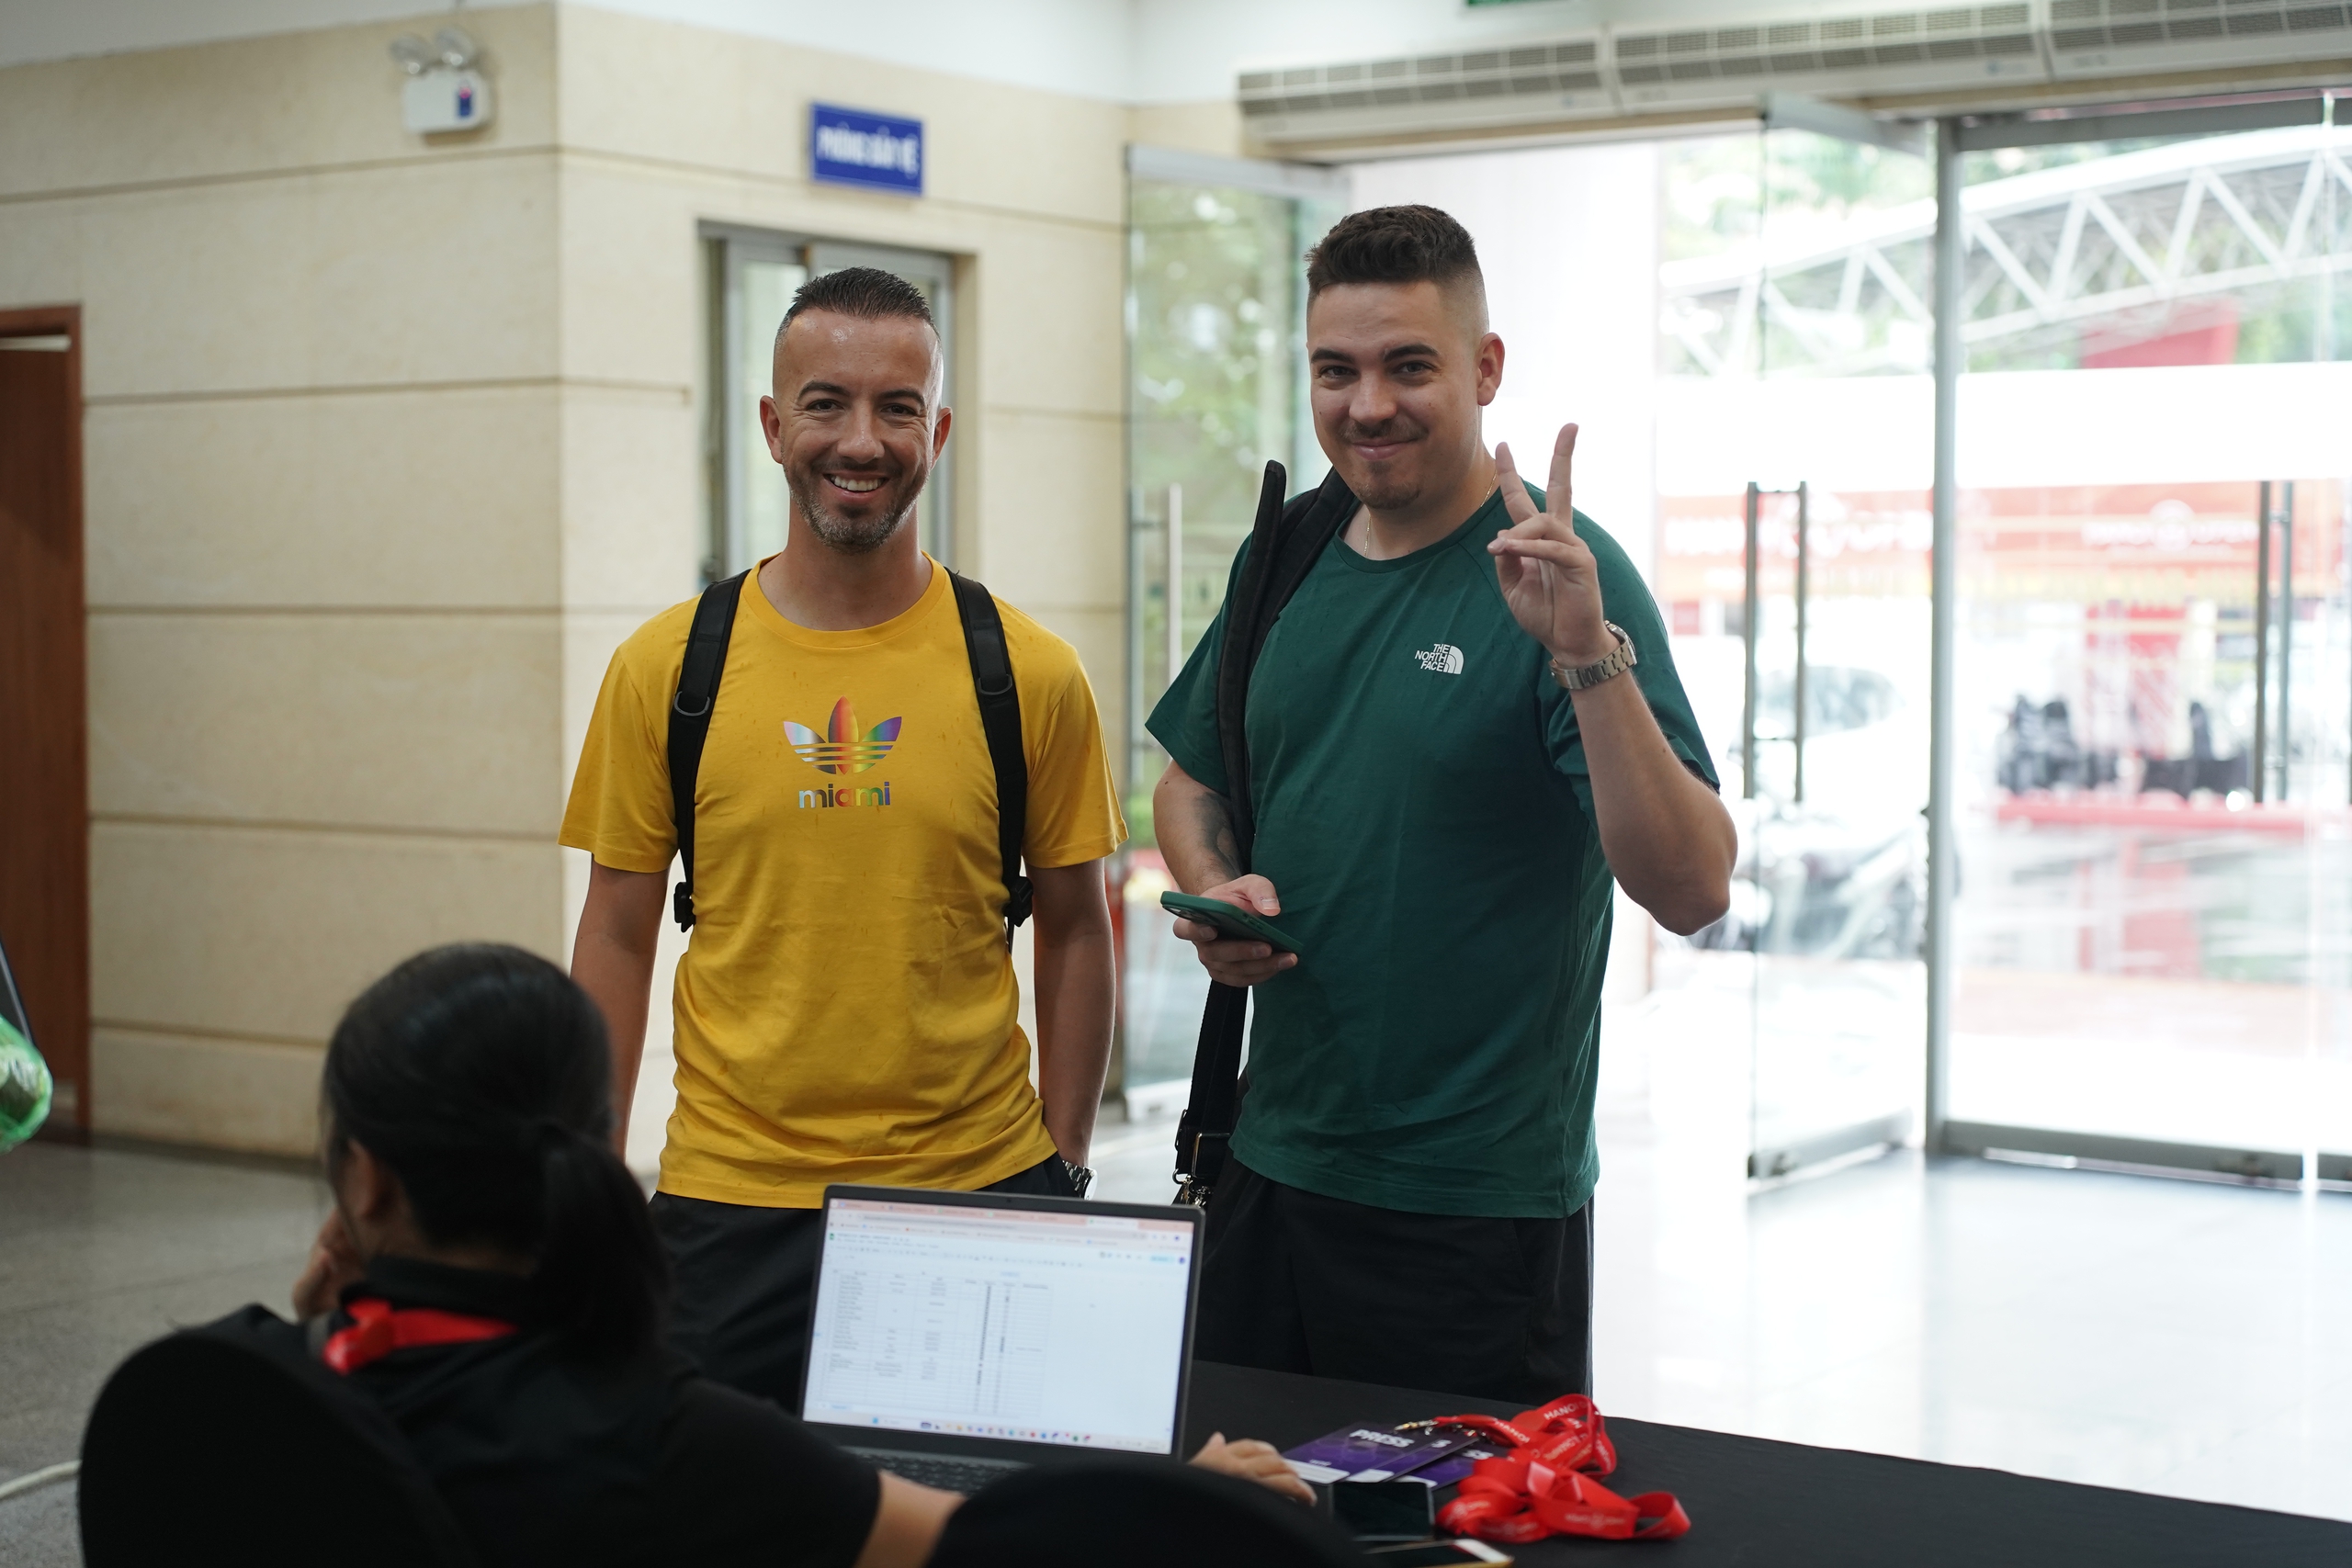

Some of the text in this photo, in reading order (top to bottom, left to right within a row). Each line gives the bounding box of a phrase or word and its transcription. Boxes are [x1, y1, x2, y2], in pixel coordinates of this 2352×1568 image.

[1433, 643, 1450, 654] THE
[1415, 650, 1447, 662] NORTH
[1420, 660, 1444, 671] FACE
[798, 781, 890, 808] miami
[1349, 1428, 1415, 1448] PRESS
